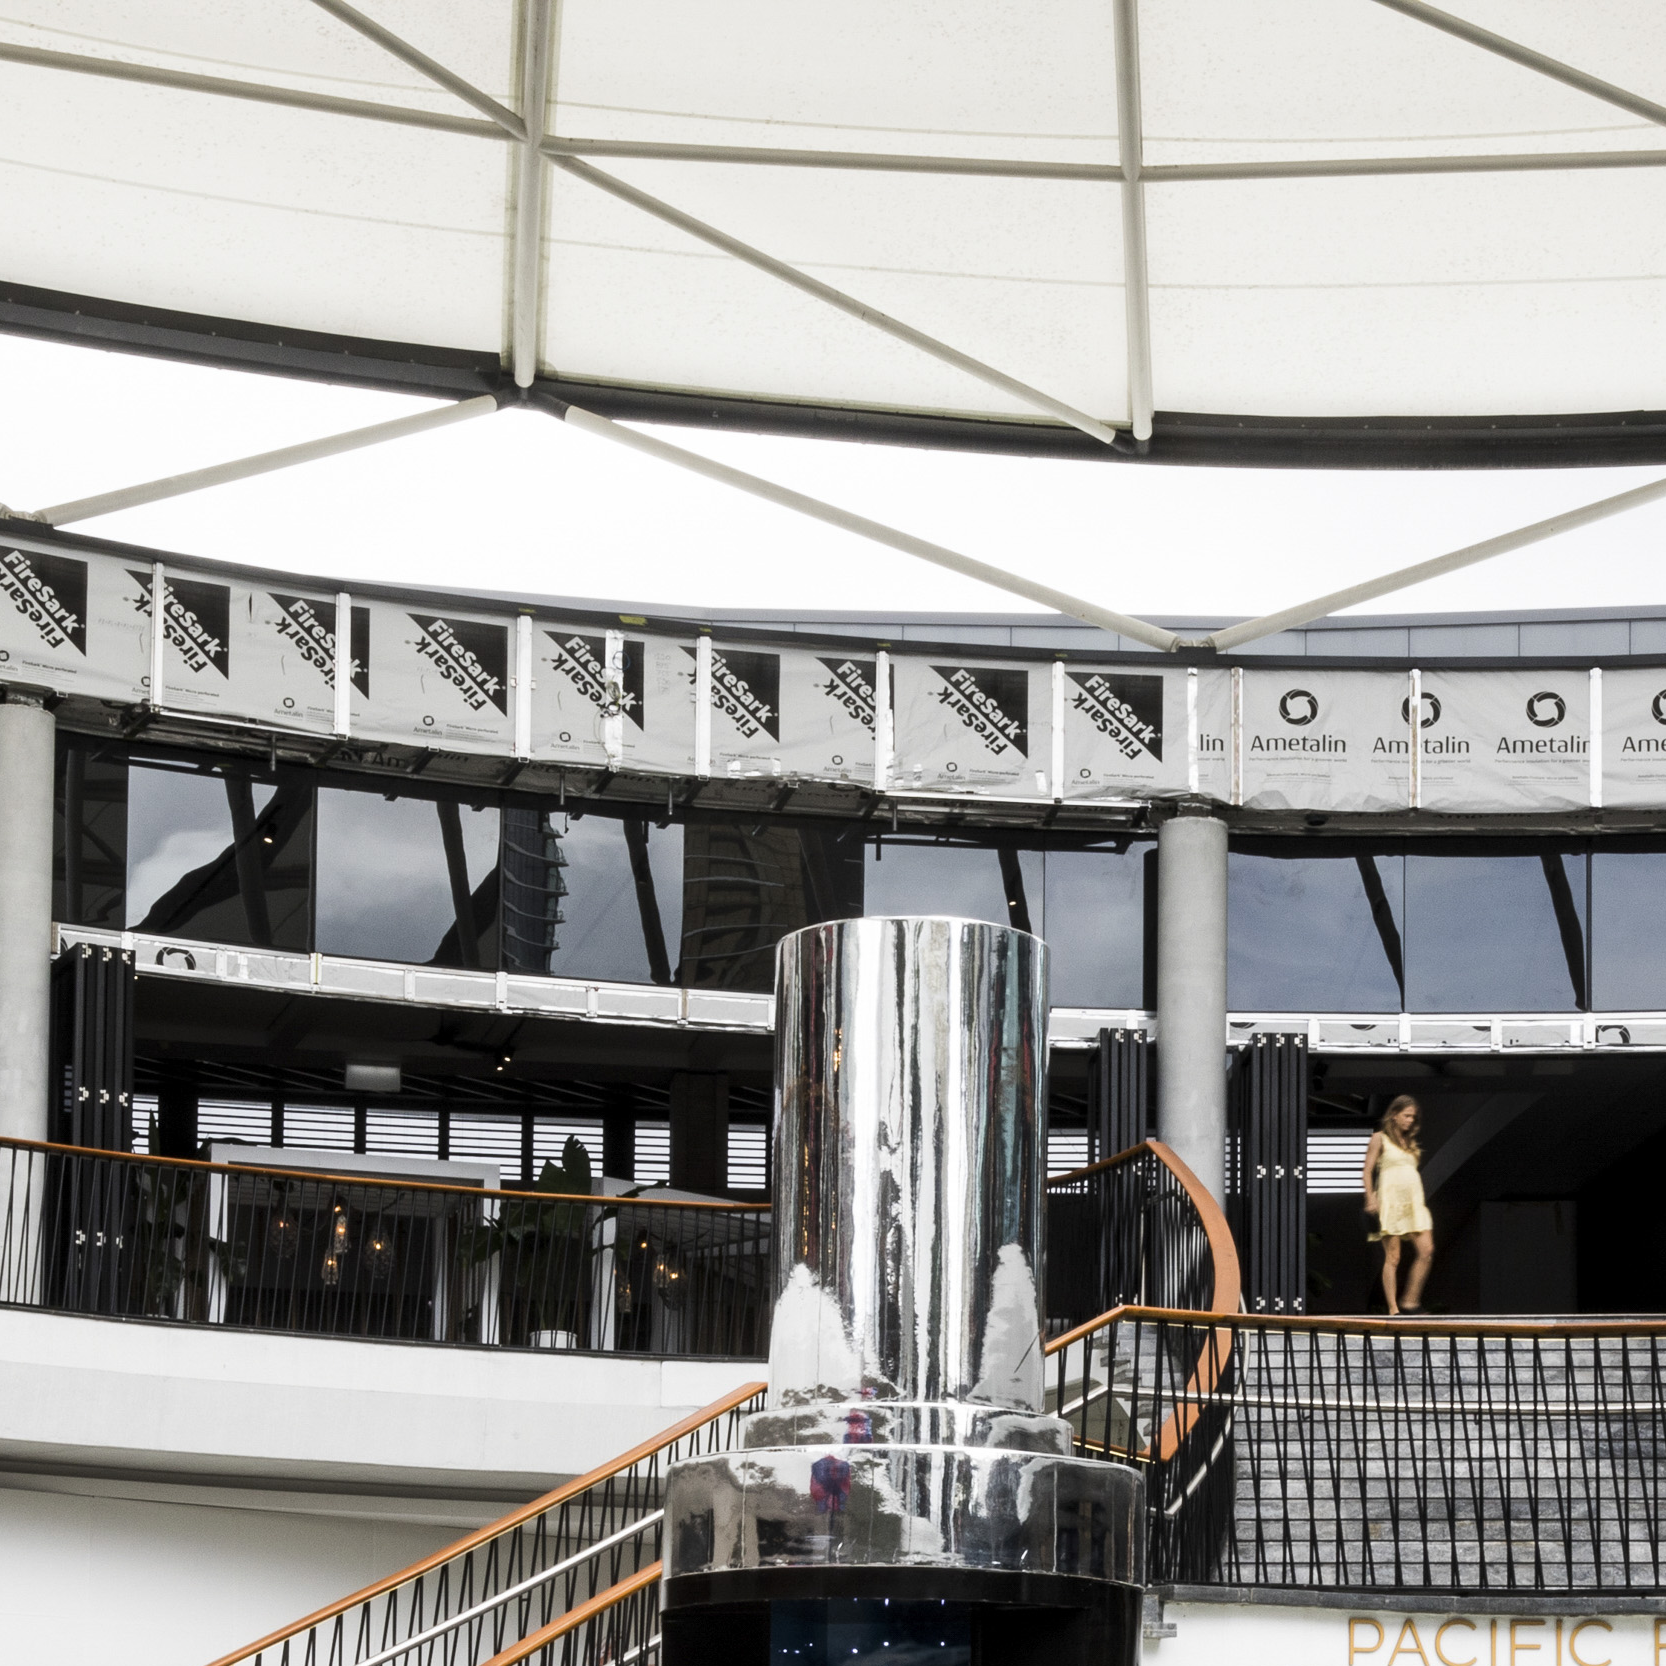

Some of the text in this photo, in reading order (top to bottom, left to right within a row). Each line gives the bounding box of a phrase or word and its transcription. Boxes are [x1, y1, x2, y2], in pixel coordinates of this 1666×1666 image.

[3, 549, 79, 635] FireSark
[132, 593, 208, 673] FireSrk
[274, 616, 336, 690] ireSark
[288, 600, 362, 679] FireSk
[428, 619, 500, 696] FireSark
[415, 635, 487, 712] FireSark
[564, 636, 637, 711] Firek
[687, 668, 759, 739] FireSa
[836, 661, 876, 707] Fire
[950, 669, 1021, 740] FireSark
[823, 678, 876, 741] reSark
[937, 686, 1008, 756] FireSark
[1073, 691, 1142, 760] FireSark
[1085, 675, 1155, 746] FireSark
[1250, 734, 1347, 753] Ametalin
[1373, 736, 1470, 754] Amtalin
